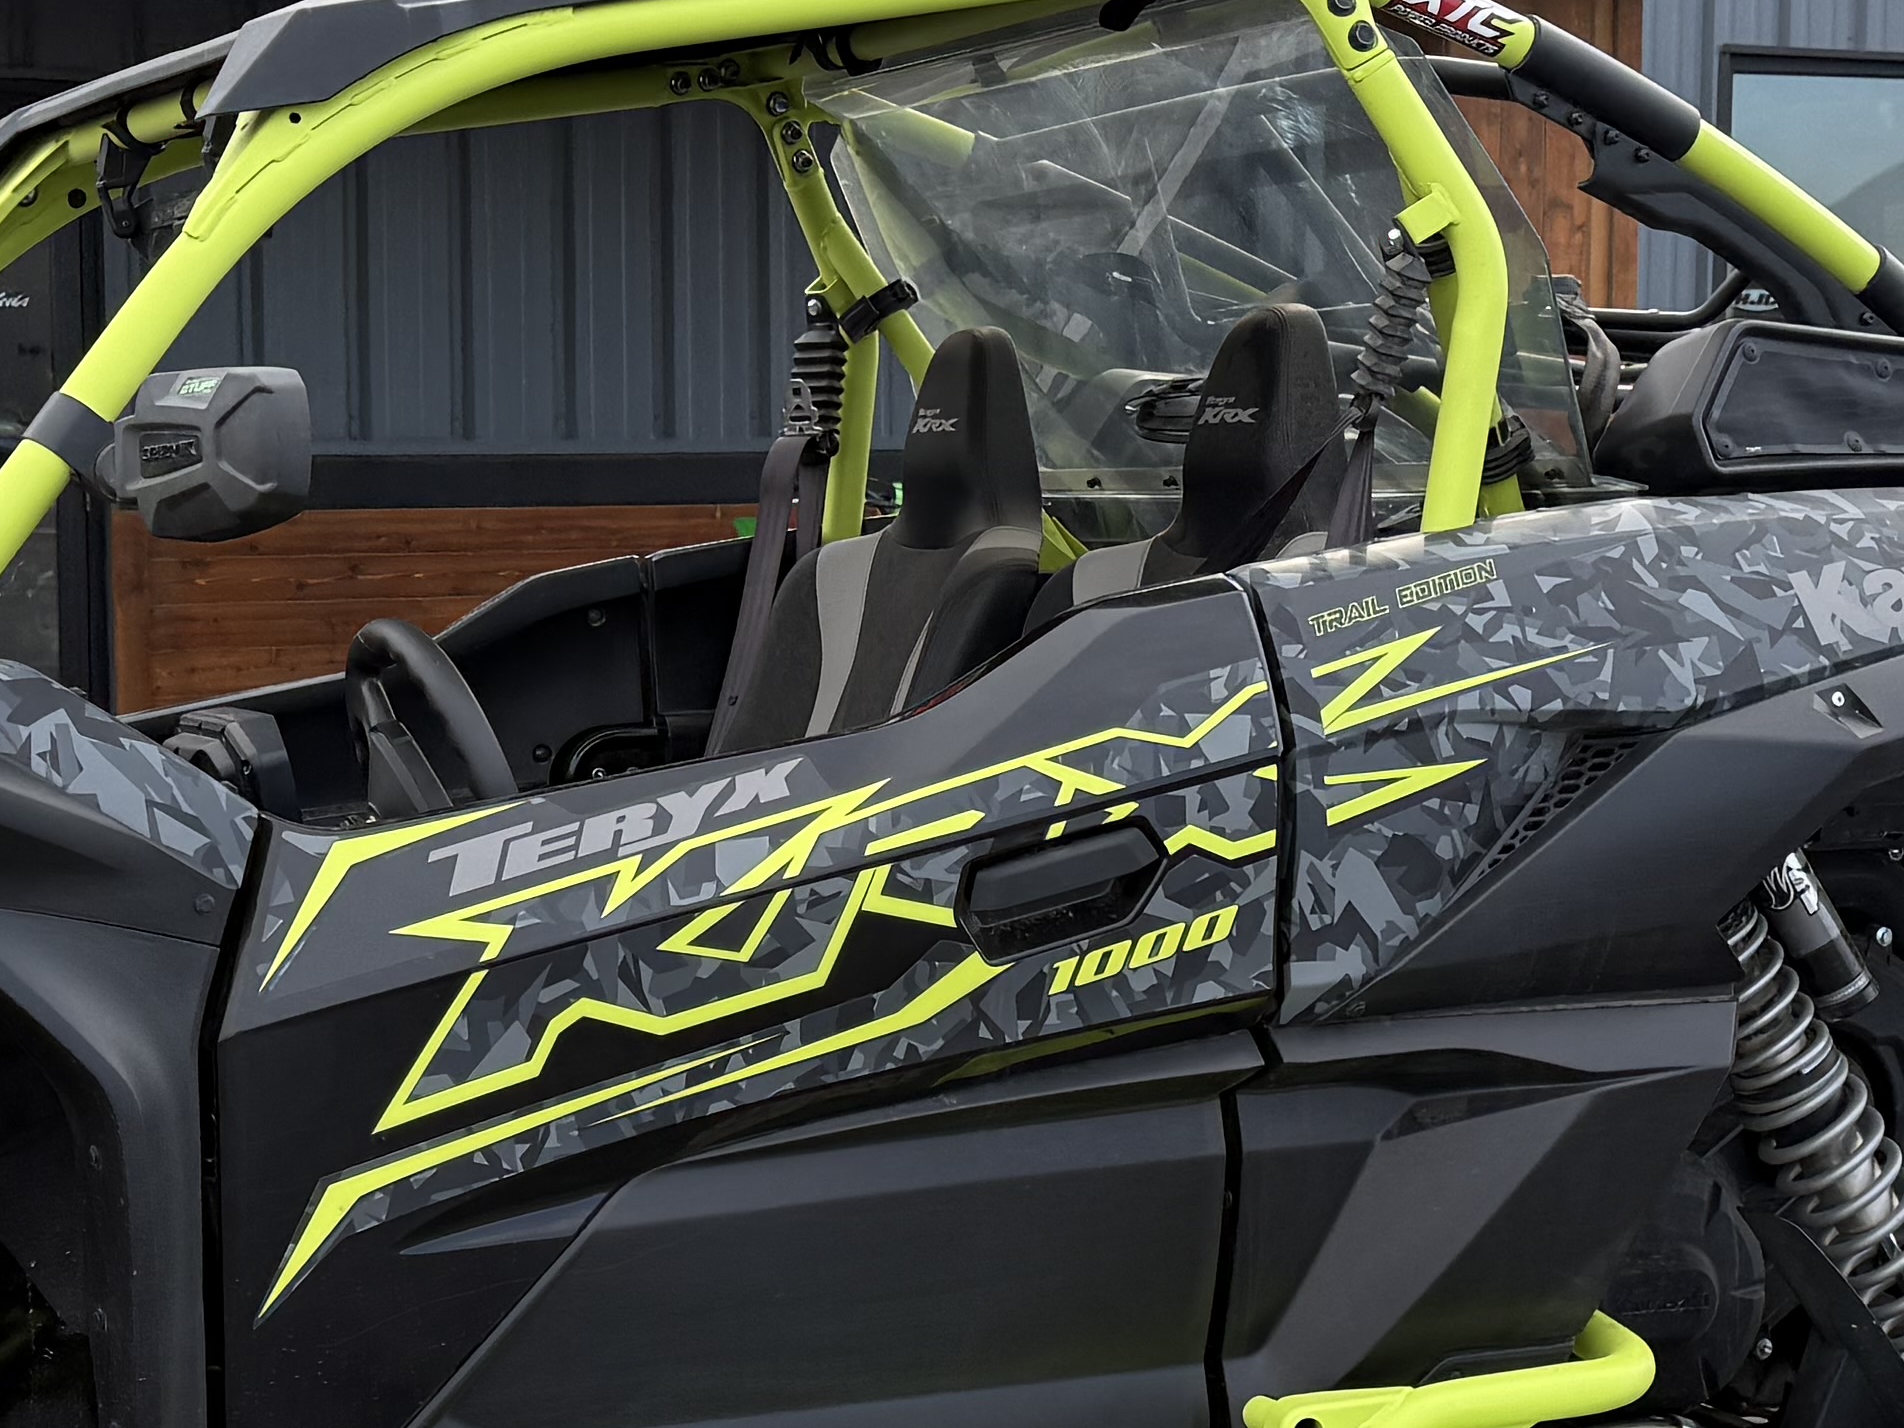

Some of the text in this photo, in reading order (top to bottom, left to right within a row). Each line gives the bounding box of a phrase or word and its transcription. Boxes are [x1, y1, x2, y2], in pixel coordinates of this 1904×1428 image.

[1197, 406, 1260, 425] KRX
[1308, 558, 1498, 637] TRAIL EDITION
[427, 757, 805, 897] TERYX
[1047, 903, 1240, 997] 1000
